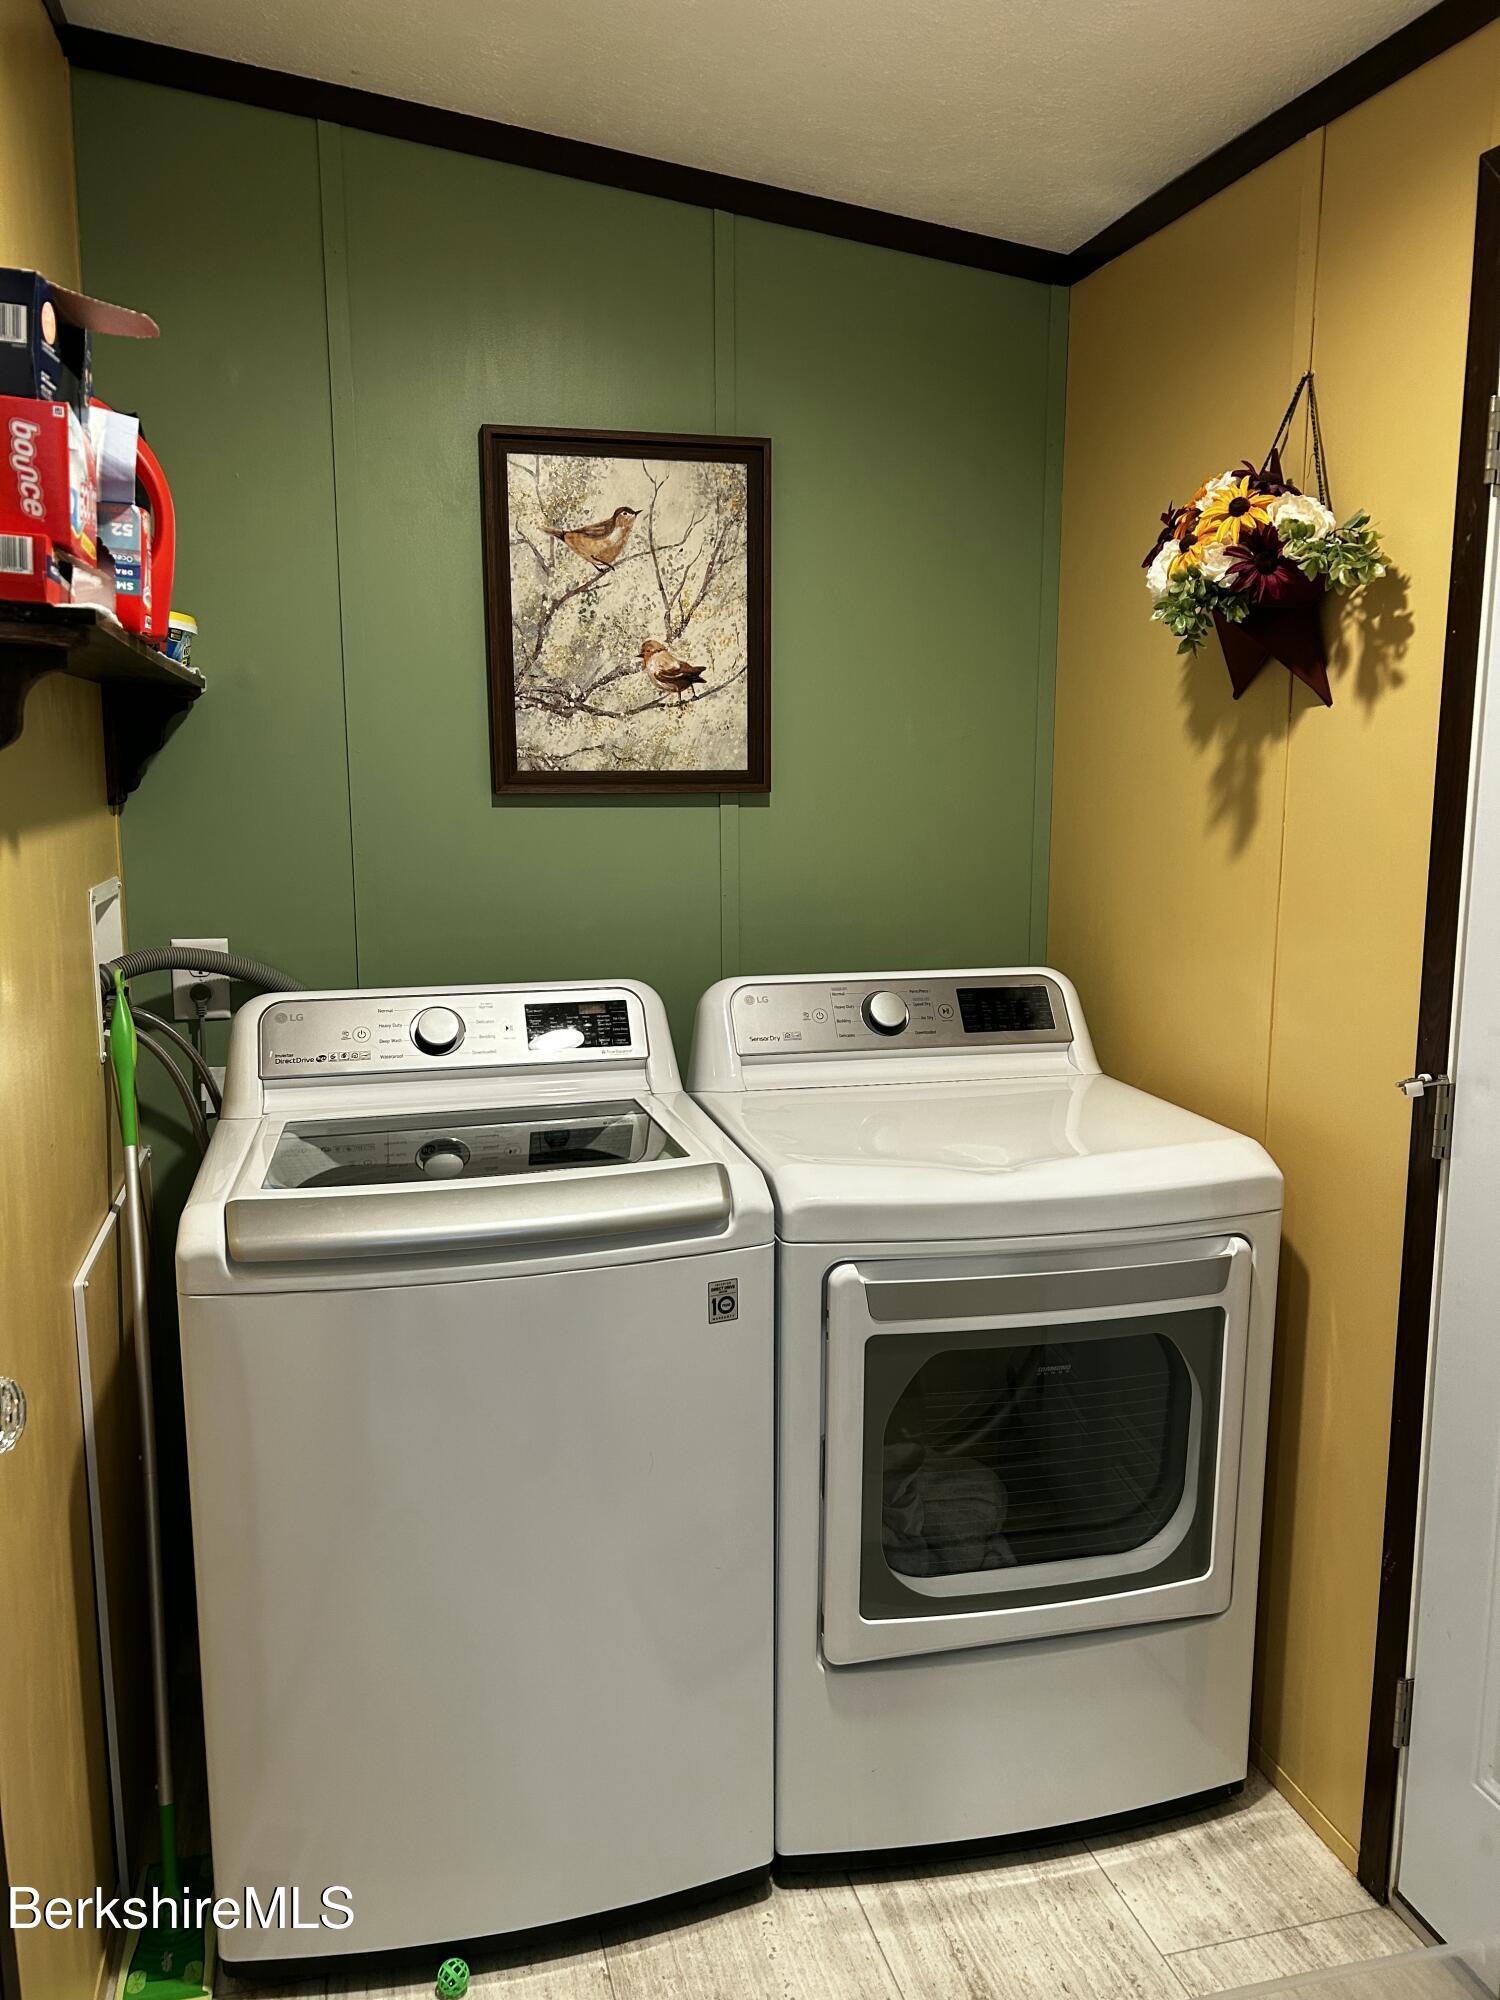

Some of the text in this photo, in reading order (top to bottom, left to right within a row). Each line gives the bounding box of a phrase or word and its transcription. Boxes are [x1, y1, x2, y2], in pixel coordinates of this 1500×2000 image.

[9, 417, 45, 518] bounce
[111, 522, 134, 537] 52
[756, 996, 769, 1004] LG
[290, 1014, 304, 1022] LG
[274, 1057, 315, 1065] DirectDrive
[712, 1296, 735, 1316] 10
